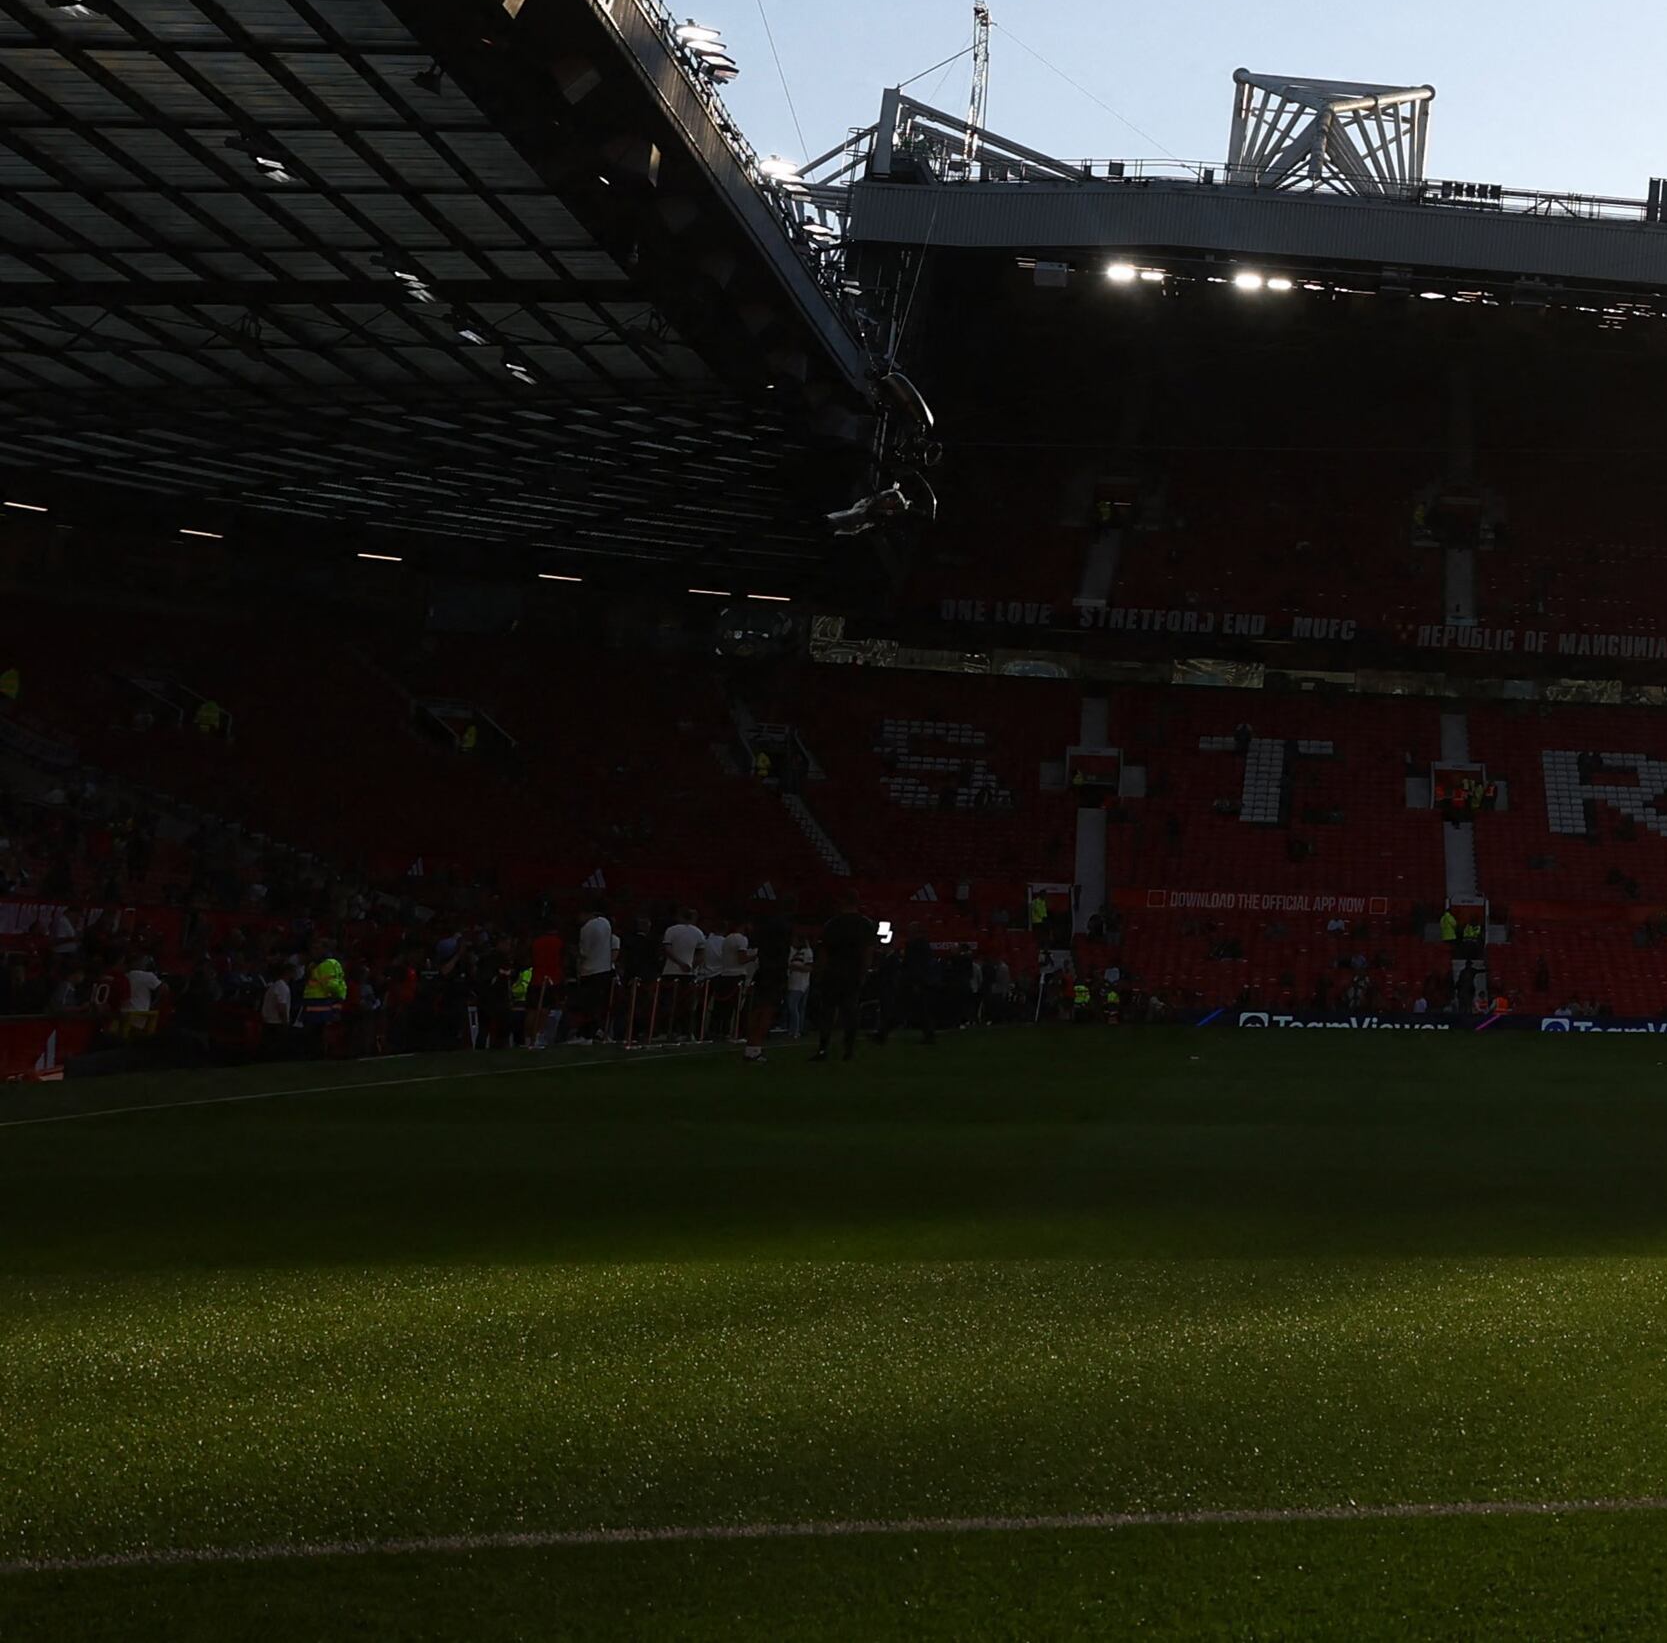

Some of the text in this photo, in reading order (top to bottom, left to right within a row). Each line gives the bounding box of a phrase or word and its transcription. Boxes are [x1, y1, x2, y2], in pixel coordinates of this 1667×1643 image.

[1222, 613, 1267, 636] END
[1291, 616, 1358, 641] MUFC
[1523, 631, 1549, 654] OF
[1170, 891, 1365, 913] DOWNLOAD THE OFFICIAL APP NOW
[91, 982, 111, 1005] 10
